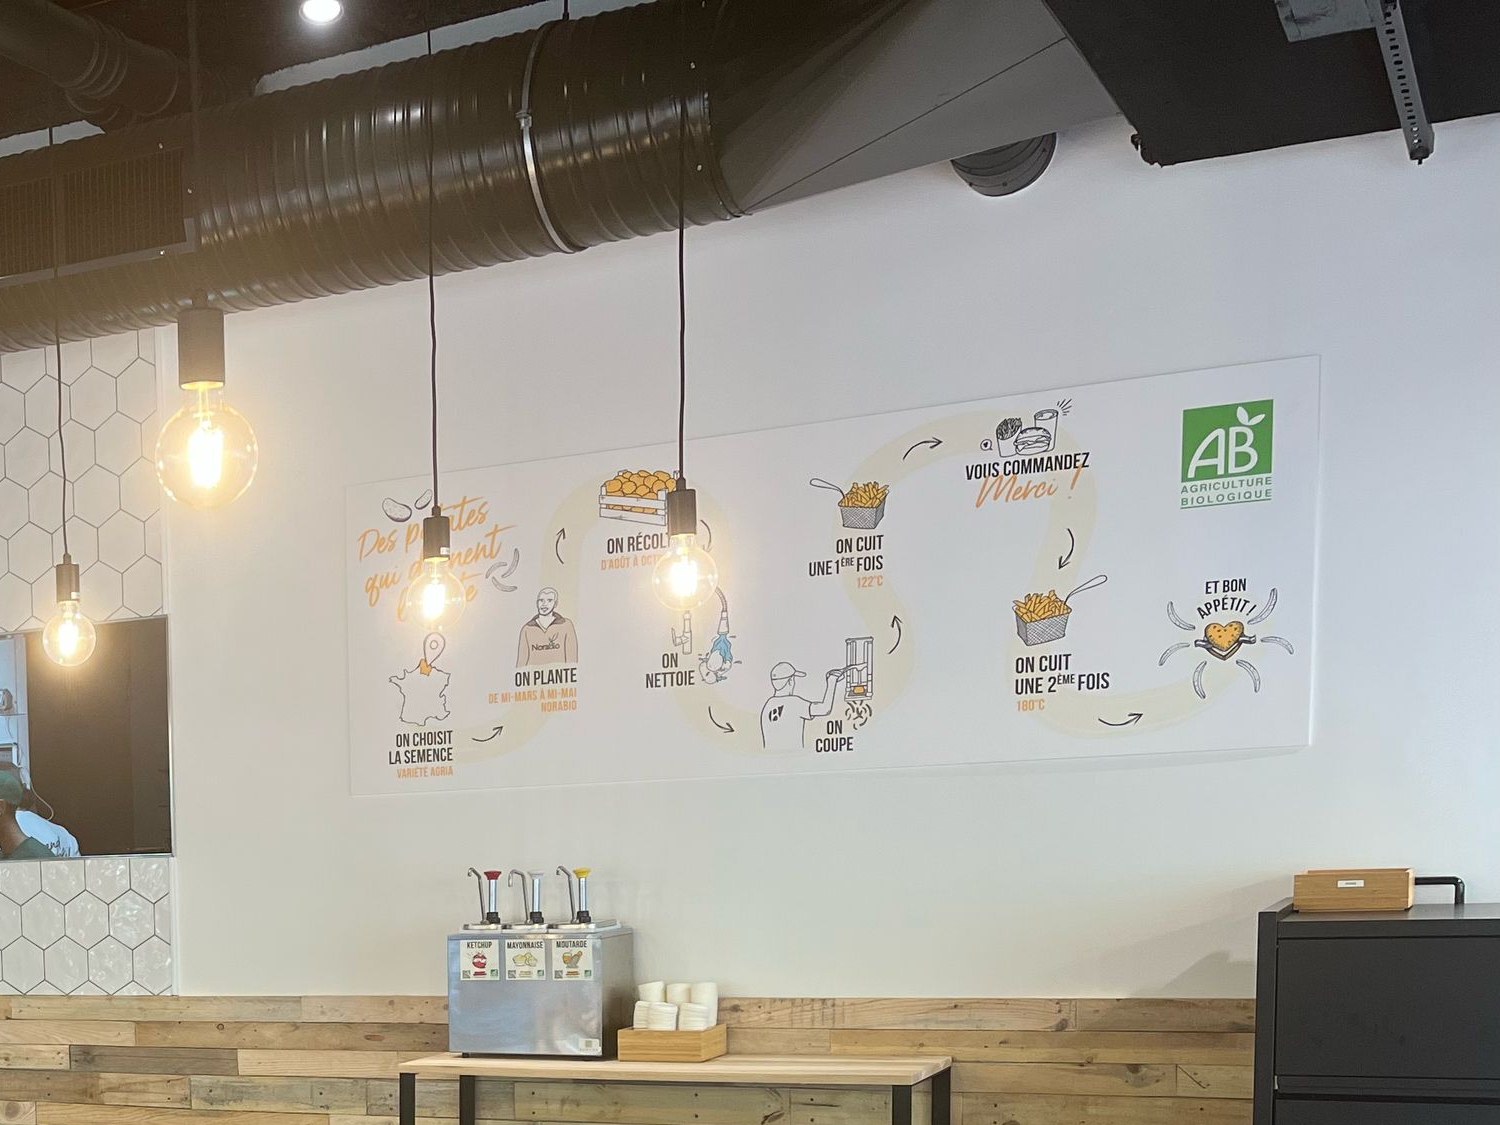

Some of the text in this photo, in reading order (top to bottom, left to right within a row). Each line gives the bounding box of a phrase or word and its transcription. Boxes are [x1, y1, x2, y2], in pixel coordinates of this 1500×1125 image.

[1187, 425, 1258, 478] AB
[965, 452, 1090, 480] VOUS COMMANDEZ
[975, 474, 1058, 508] Merci
[1180, 476, 1272, 495] AGRICULTURE
[1180, 488, 1272, 506] BIOLOGIQUE
[357, 529, 398, 564] Des
[606, 537, 624, 555] ON
[836, 534, 884, 554] ON CUIT
[808, 560, 833, 577] UNE
[856, 554, 883, 572] FOIS
[365, 566, 400, 607] qui
[1205, 578, 1247, 595] ET BON
[1196, 594, 1251, 620] APPÉTIT
[662, 652, 679, 669] ON
[1015, 653, 1072, 674] ON CUIT
[515, 667, 578, 688] ON PLANTE
[645, 670, 695, 689] NETTOIE
[1015, 677, 1043, 695] UNE
[1077, 672, 1110, 691] FOIS
[488, 692, 499, 704] DE
[501, 690, 538, 703] MI-MARS
[547, 687, 577, 700] MI-MAI
[541, 699, 578, 713] NORABIO
[826, 719, 843, 735] ON
[395, 730, 453, 748] ON CHOISIT
[815, 736, 854, 752] COUPE
[388, 747, 453, 765] LA SEMENCE
[430, 765, 453, 777] AGRIA
[466, 940, 493, 949] KETCHUP
[507, 941, 544, 949] MAYONNAISE
[556, 940, 588, 948] MOUTARDE
